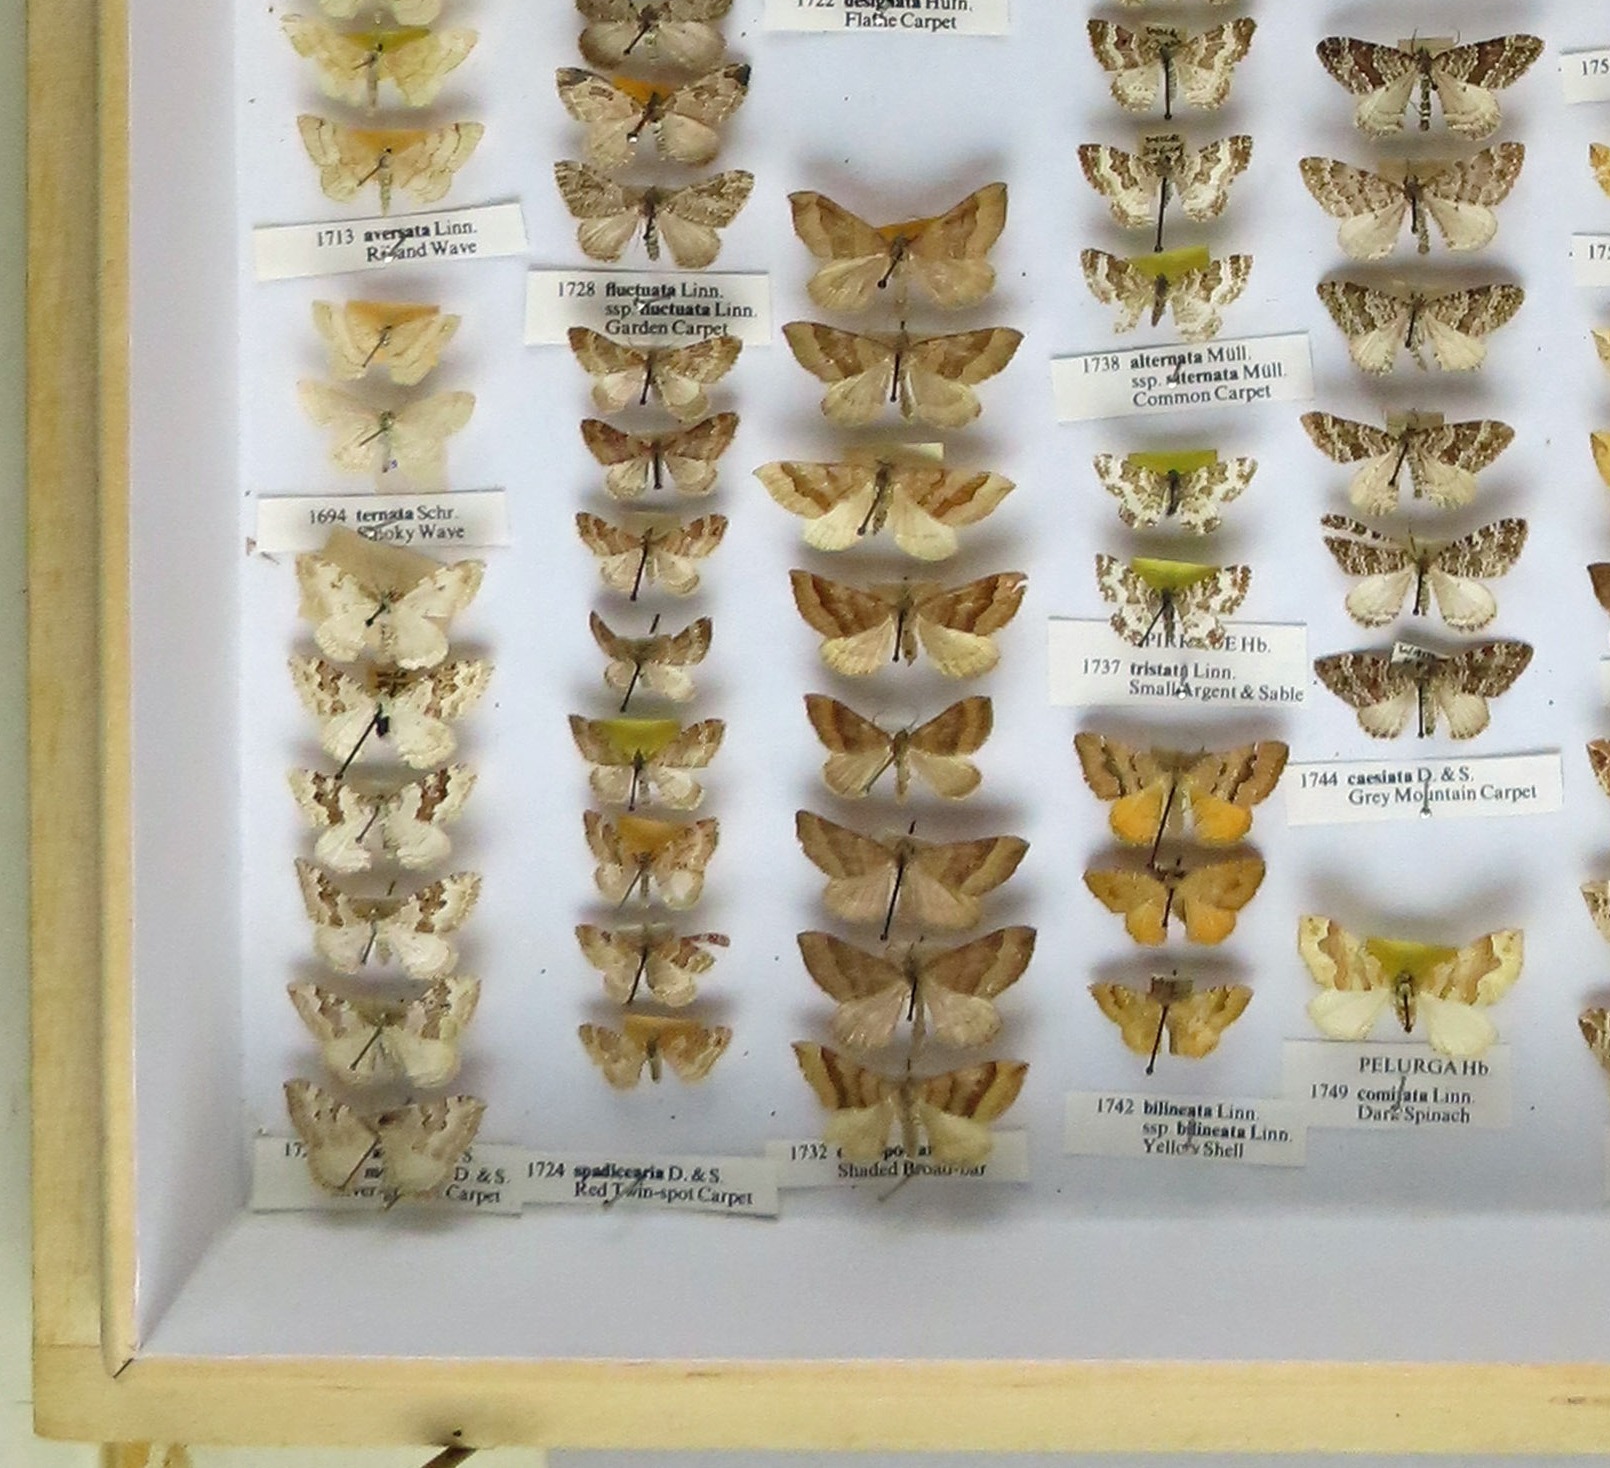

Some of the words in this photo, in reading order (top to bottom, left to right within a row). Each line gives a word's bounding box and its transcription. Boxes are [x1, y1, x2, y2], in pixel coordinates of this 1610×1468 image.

[317, 229, 354, 247] 1713
[434, 220, 477, 236] Linn.
[605, 319, 669, 336] Garden
[672, 321, 728, 339] Carpet
[1082, 355, 1120, 373] 1738
[1130, 351, 1203, 370] alternata
[1132, 389, 1211, 407] Common
[1214, 385, 1272, 404] Carpet
[1301, 770, 1338, 788] 1744
[1310, 1083, 1349, 1099] 1749
[527, 1161, 564, 1178] 1724
